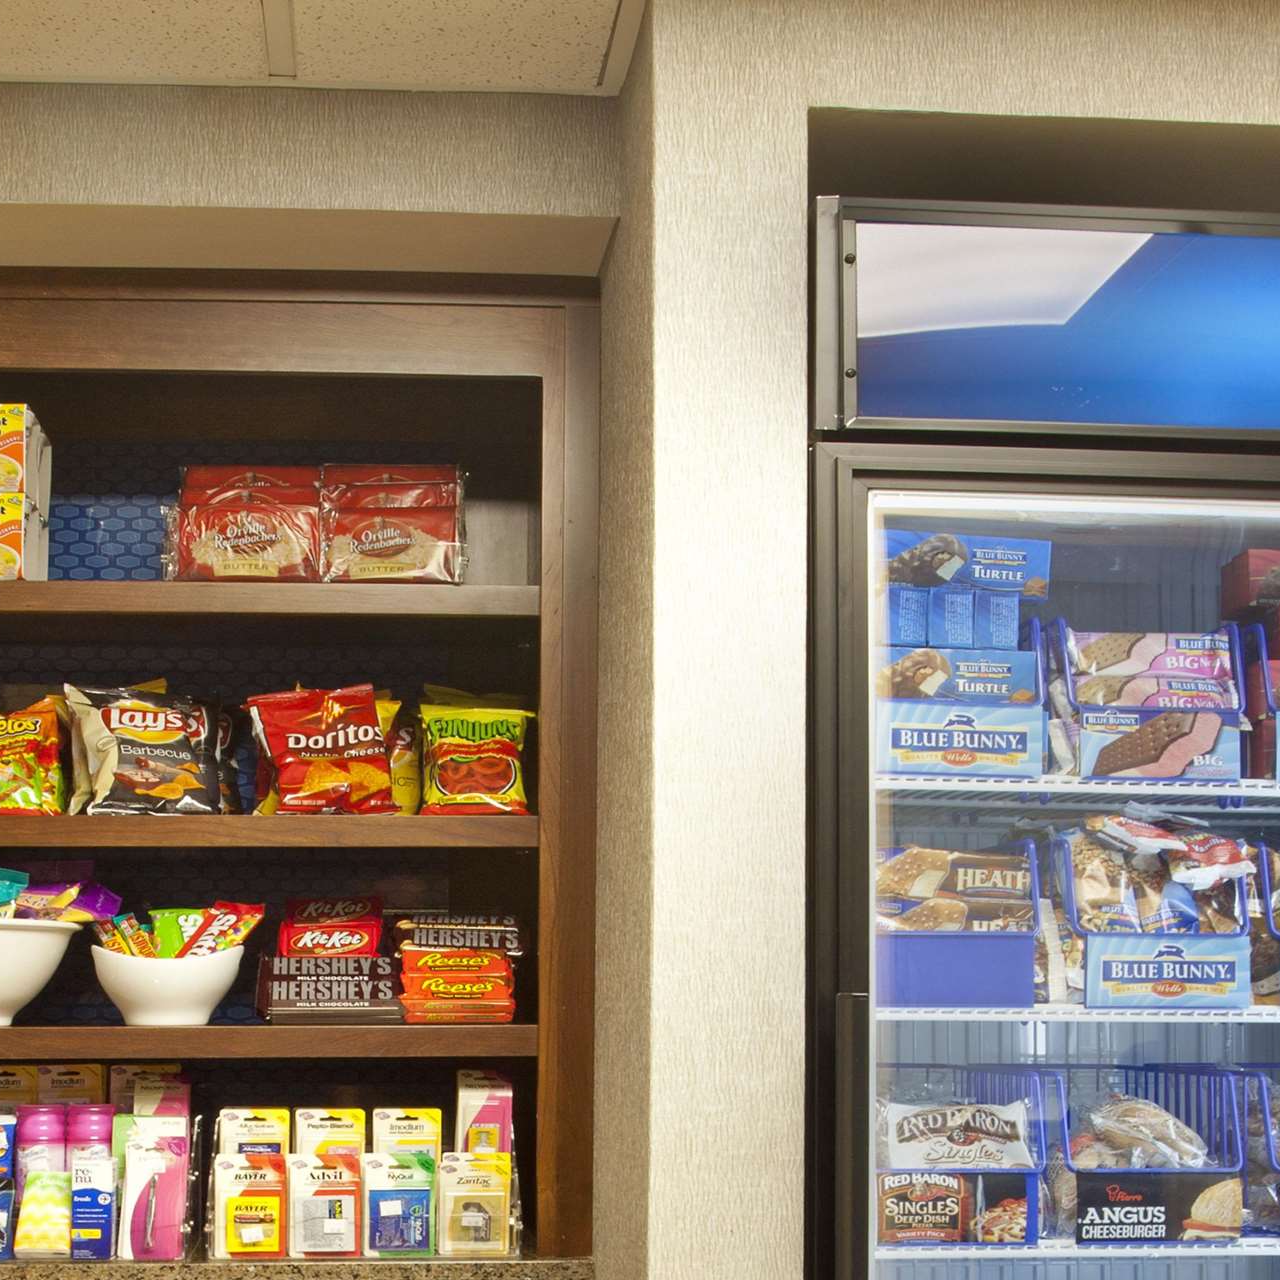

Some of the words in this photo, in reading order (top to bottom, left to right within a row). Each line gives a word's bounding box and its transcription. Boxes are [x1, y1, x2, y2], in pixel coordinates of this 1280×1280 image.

[361, 528, 400, 542] Orville
[976, 551, 995, 560] BLUE
[998, 552, 1025, 561] BUNNY
[972, 565, 1024, 581] TURTLE
[1179, 639, 1203, 650] BLUE
[959, 664, 978, 672] BLUE
[981, 664, 1009, 673] BUNNY
[1166, 656, 1200, 669] BIG
[956, 679, 1009, 694] TURTLE
[1172, 682, 1195, 692] BLUE
[110, 710, 183, 732] Lay's
[1087, 717, 1104, 725] BLUE
[1106, 717, 1138, 726] BUNNY
[287, 724, 384, 749] Doritos
[428, 718, 520, 743] FUNYUNS
[900, 730, 948, 747] BLUE
[953, 731, 1021, 748] BUNNY
[120, 745, 192, 761] Barbecue
[1193, 755, 1223, 767] BIG
[957, 869, 1031, 891] HEATH
[413, 929, 519, 948] HERSHEY'S
[273, 958, 392, 975] HERSHEY'S
[417, 953, 490, 967] Reese's
[1112, 963, 1157, 978] BLUE
[1163, 963, 1230, 978] BUNNY
[273, 981, 393, 1000] HERSHEY'S
[422, 977, 494, 993] Reese's
[904, 1113, 941, 1137] RED
[924, 1142, 1004, 1163] Singles
[310, 1171, 343, 1180] Advil
[457, 1177, 492, 1185] Zantac
[884, 1175, 911, 1189] RED
[914, 1174, 958, 1189] BARON
[885, 1198, 959, 1215] SINGLES
[894, 1215, 921, 1224] DEEP
[923, 1215, 949, 1224] DISH
[1085, 1206, 1166, 1223] ANGUS
[1082, 1225, 1166, 1239] CHEESEBURGER
